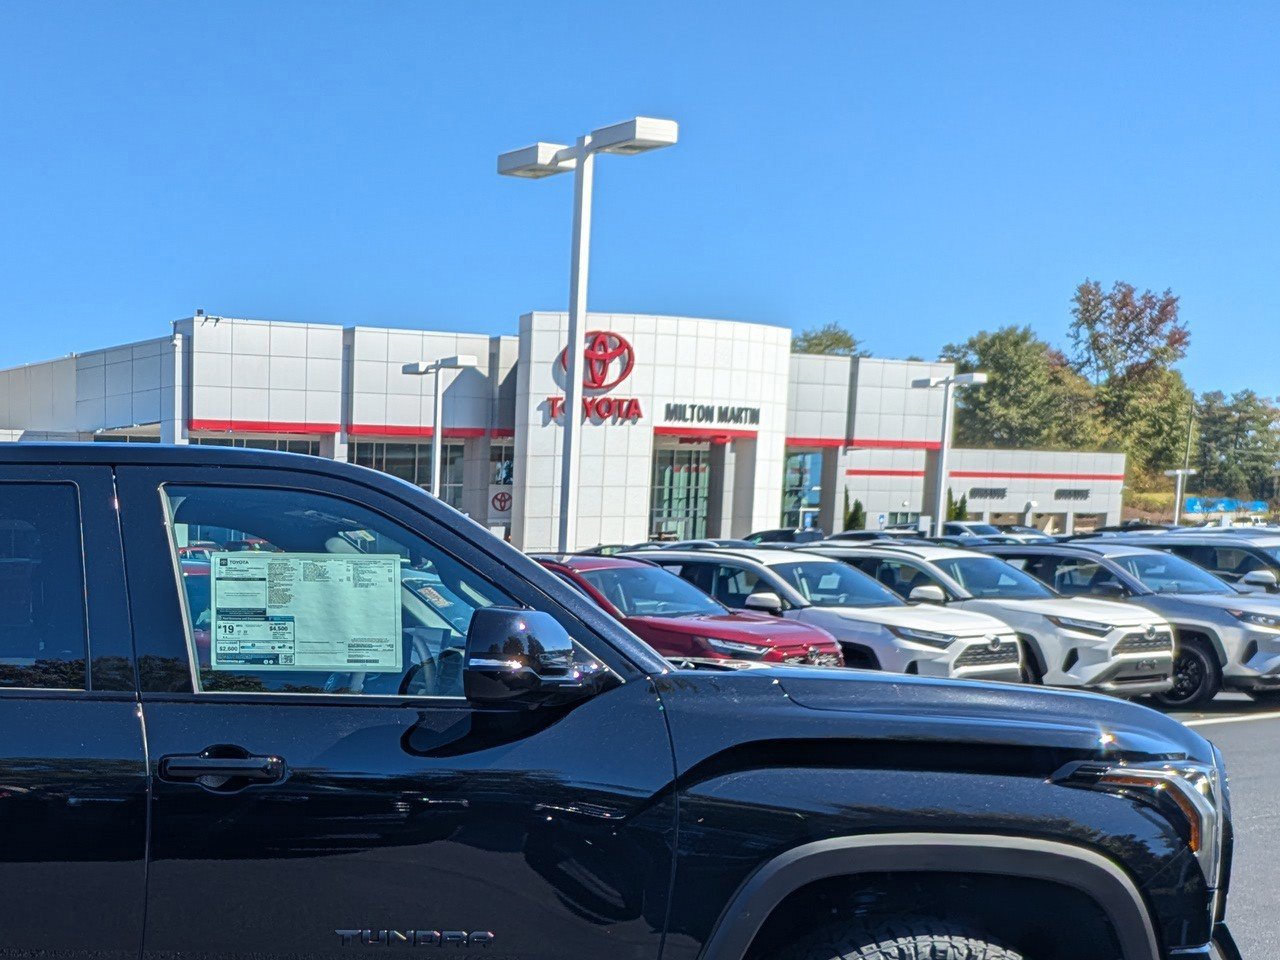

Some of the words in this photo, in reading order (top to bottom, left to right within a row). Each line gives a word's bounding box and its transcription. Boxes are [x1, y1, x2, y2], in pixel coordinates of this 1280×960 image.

[547, 397, 643, 419] TYOTA
[664, 402, 714, 423] MILTON
[717, 406, 760, 425] MARTIN
[222, 624, 234, 634] 19
[335, 929, 494, 948] TUNDRA
